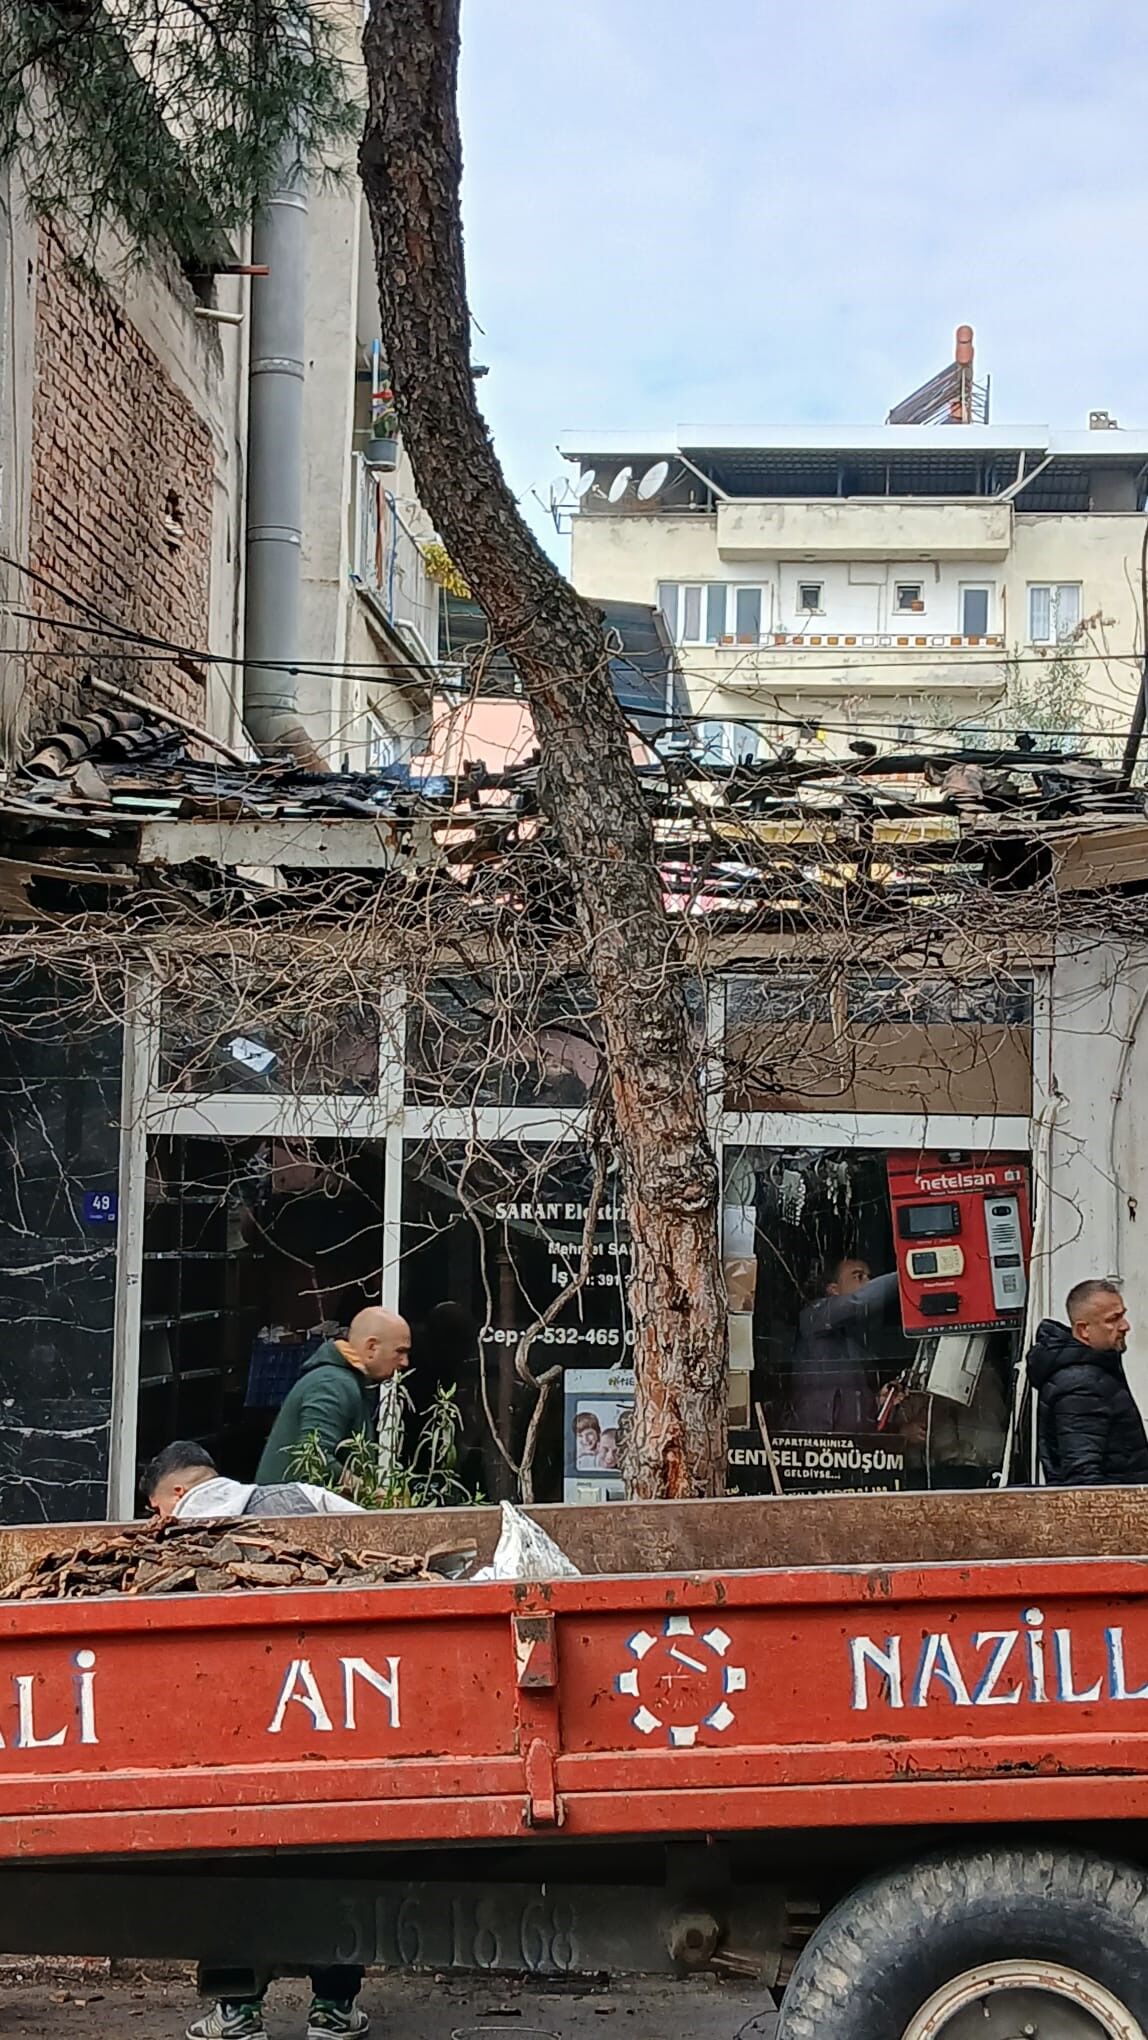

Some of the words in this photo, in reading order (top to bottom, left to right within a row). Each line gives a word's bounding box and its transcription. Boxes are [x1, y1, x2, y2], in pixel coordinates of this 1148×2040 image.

[919, 1172, 996, 1191] netelsan
[92, 1195, 110, 1210] 49
[495, 1203, 563, 1220] SARAN
[805, 1448, 904, 1473] DÖNÜŞÜM
[0, 1649, 100, 1749] Lİ
[267, 1656, 400, 1733] AN
[850, 1606, 1148, 1711] NAZİLL
